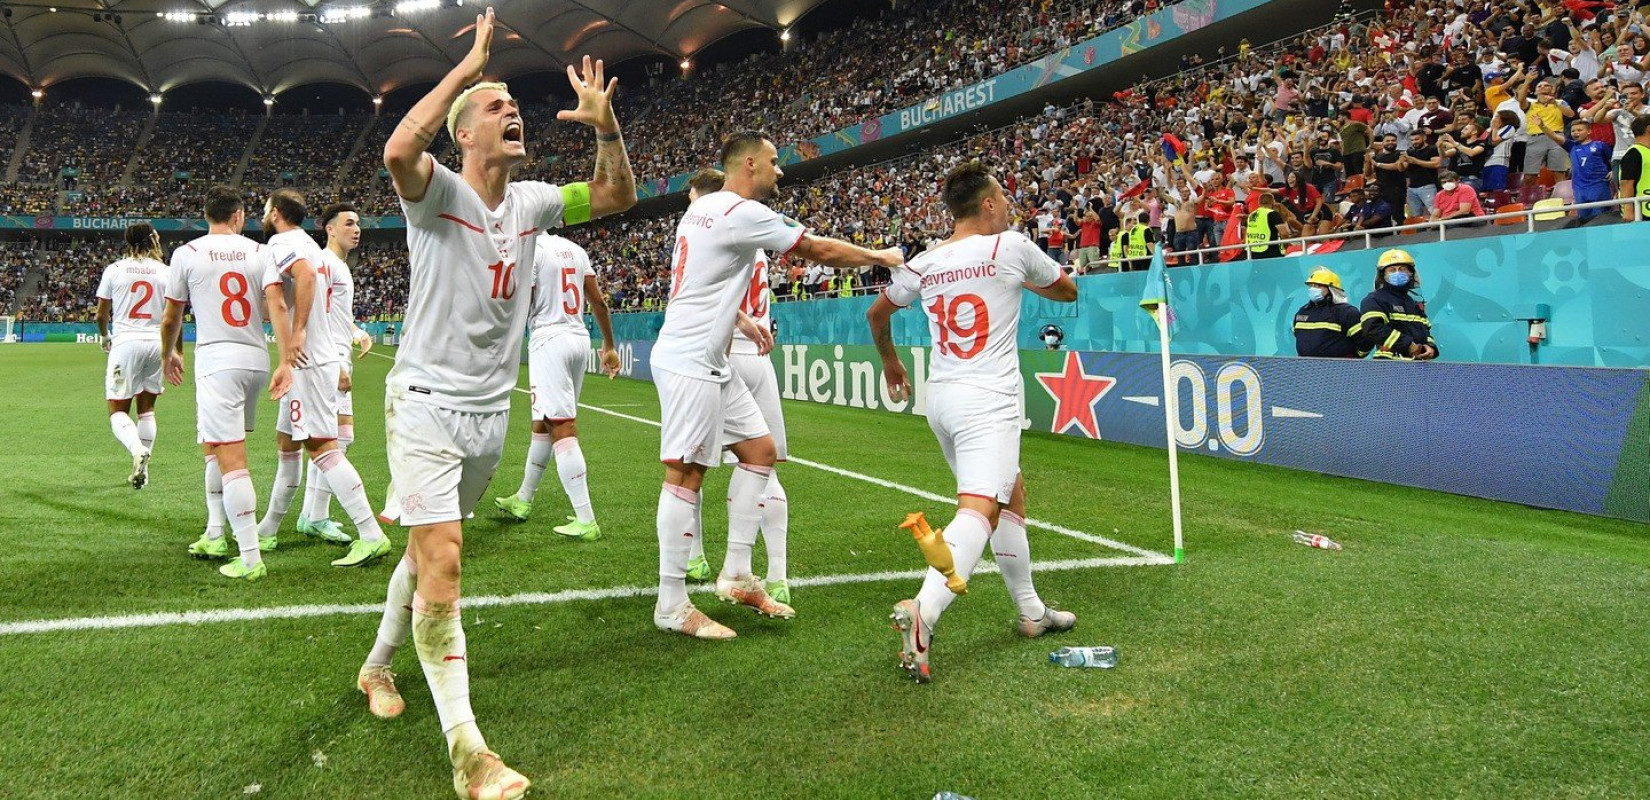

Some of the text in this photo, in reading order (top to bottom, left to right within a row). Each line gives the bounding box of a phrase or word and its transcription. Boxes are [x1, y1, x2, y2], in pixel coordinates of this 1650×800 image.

[901, 79, 997, 131] BUCHAREST
[1580, 157, 1588, 167] 7
[209, 250, 247, 262] freuler
[128, 280, 154, 320] 2
[219, 271, 252, 329] 8
[487, 260, 517, 300] 10
[562, 267, 581, 315] 5
[927, 293, 990, 360] 19
[290, 399, 302, 423] 8
[1170, 359, 1266, 456] 0.0
